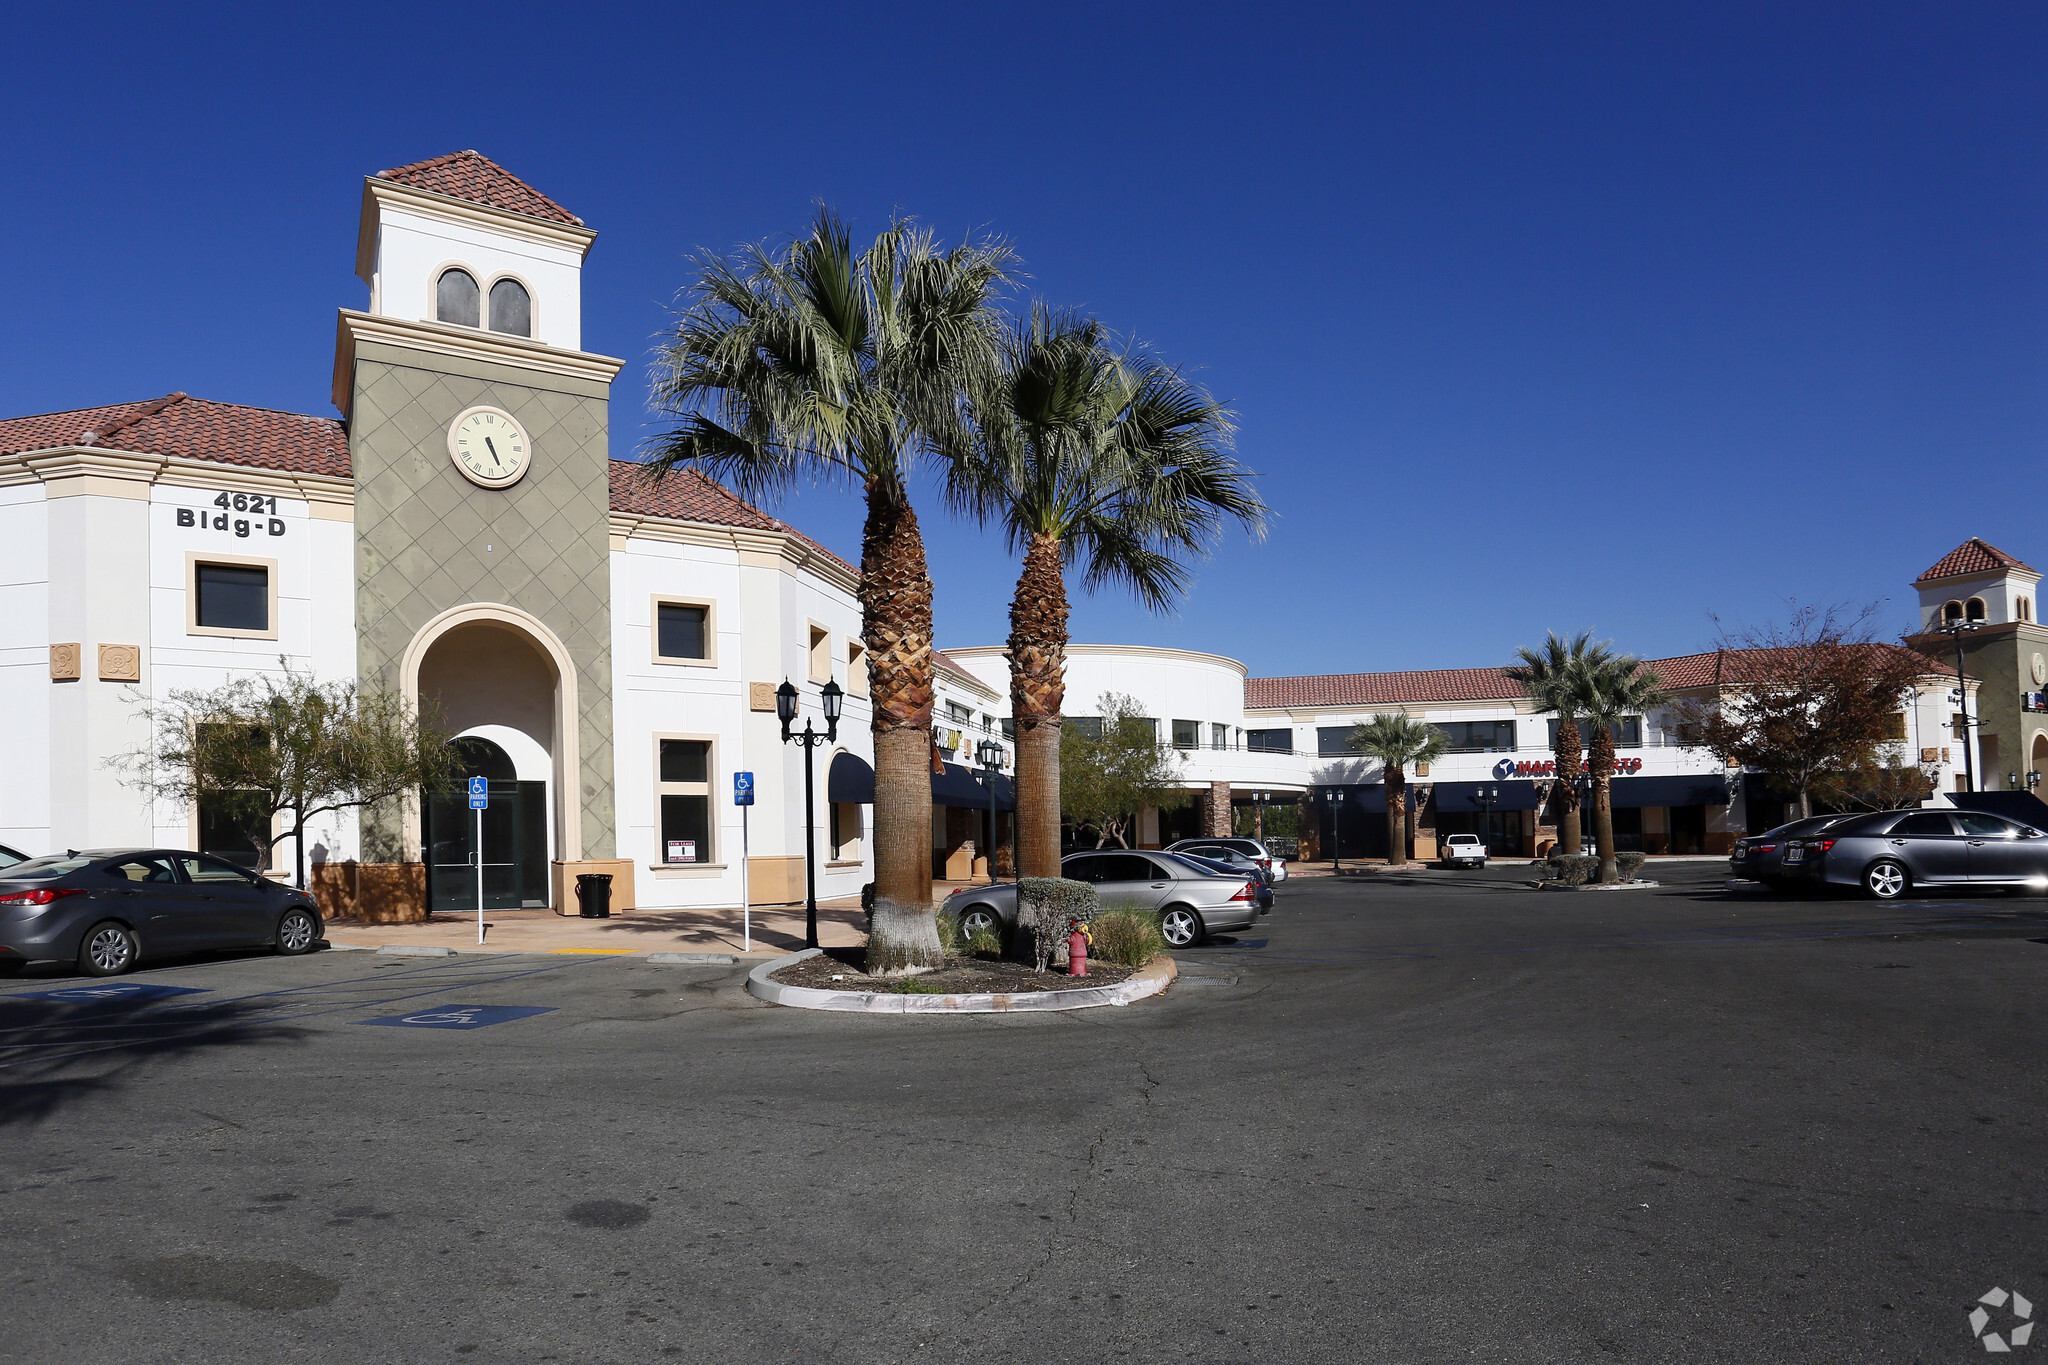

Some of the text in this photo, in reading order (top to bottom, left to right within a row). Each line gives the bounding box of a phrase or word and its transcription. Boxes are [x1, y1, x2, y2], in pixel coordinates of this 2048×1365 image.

[213, 491, 277, 515] 4621
[176, 508, 286, 538] Bldg-D
[935, 727, 963, 750] SUBWAY
[1612, 758, 1643, 771] RTS
